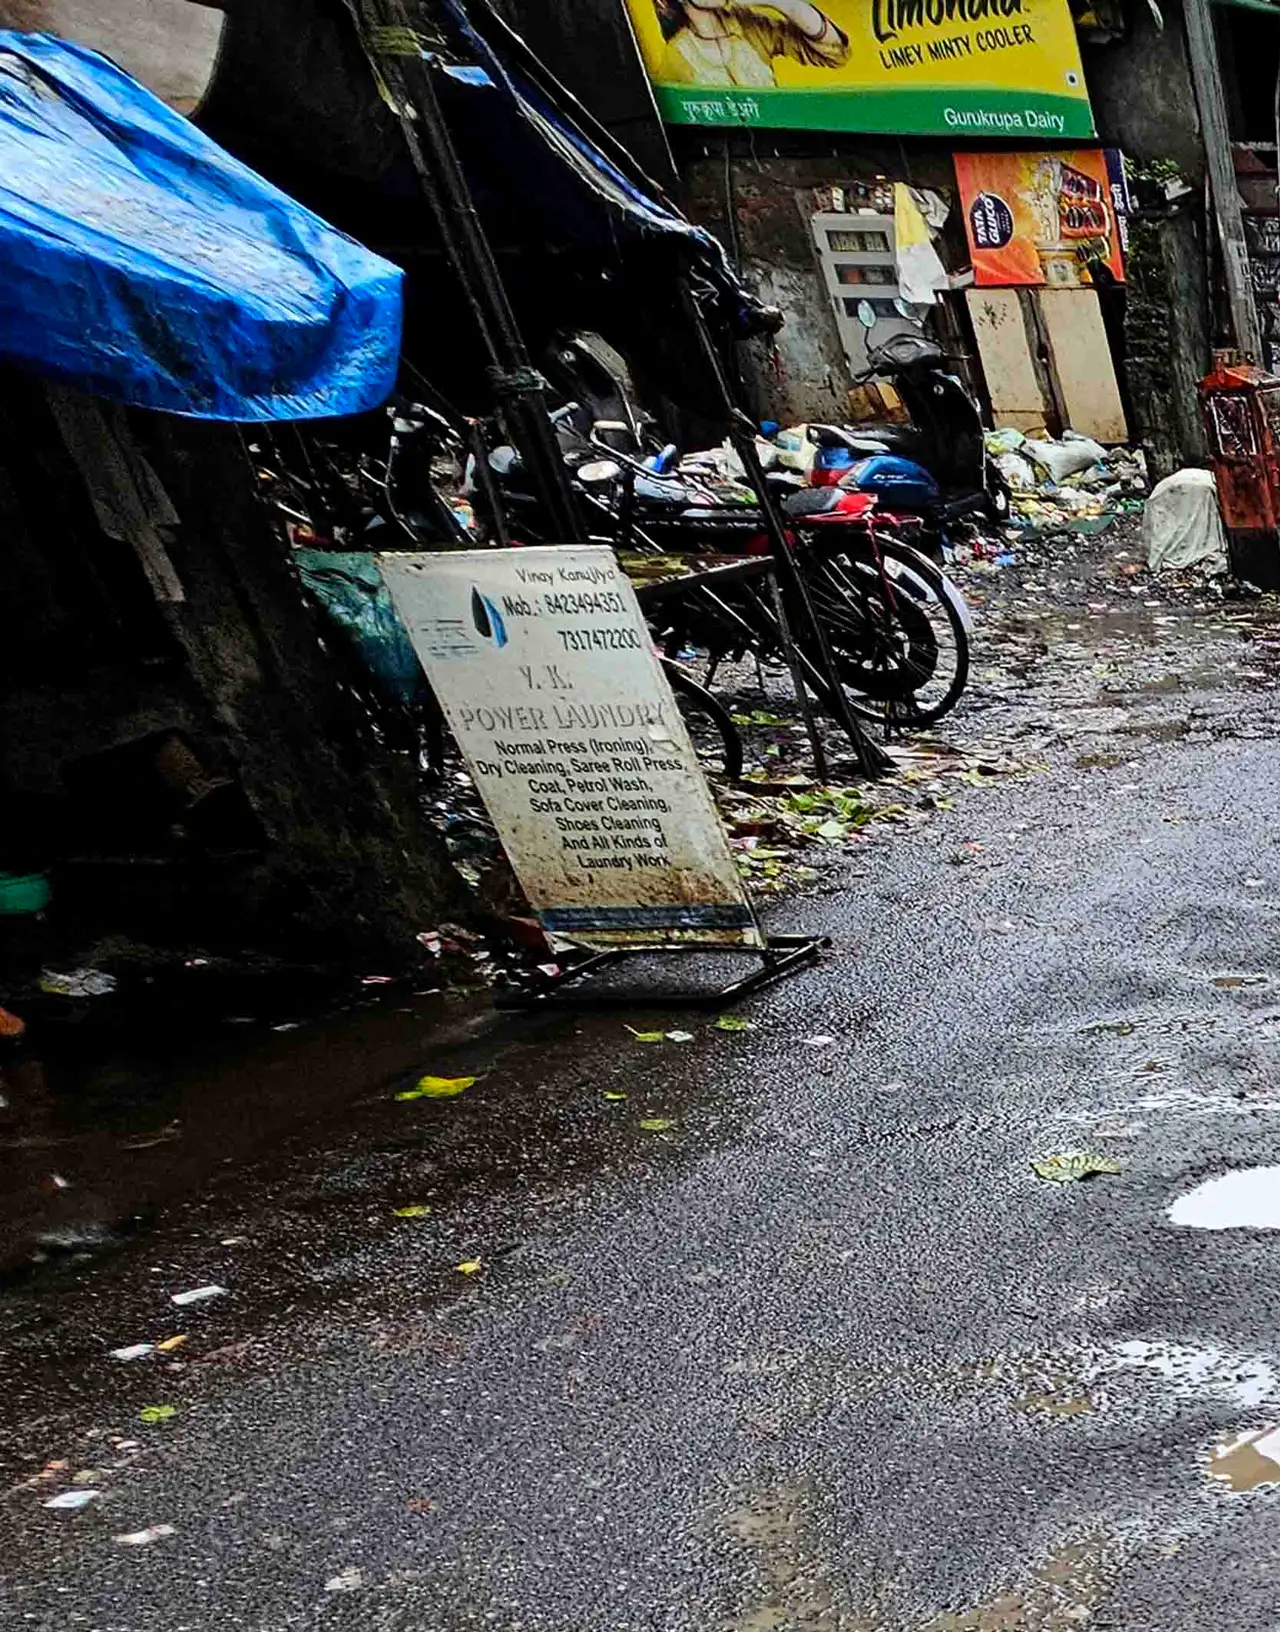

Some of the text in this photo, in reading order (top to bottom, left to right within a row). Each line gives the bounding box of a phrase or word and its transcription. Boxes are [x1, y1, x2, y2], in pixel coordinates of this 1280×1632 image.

[879, 23, 1035, 69] LIMEY MINTY COOLER
[944, 107, 1065, 132] Gurukrupa Dairy
[974, 210, 988, 244] TATA
[516, 569, 553, 586] Vinay
[544, 592, 627, 614] 8423494351
[557, 628, 642, 651] 7317472200
[459, 702, 666, 731] POWER LAUNDRY
[494, 738, 544, 756] Normal
[549, 739, 586, 755] Press
[475, 760, 502, 778] Dry
[505, 758, 570, 777] Cleaning,
[569, 758, 609, 774] Saree
[615, 756, 640, 772] Roll
[528, 777, 653, 795] Coat, Petrol Wash,
[529, 796, 671, 813] Sofa Cover Cleaning,
[555, 816, 662, 833] Shoes Cleaning
[562, 833, 668, 850] And All Kinds of
[577, 854, 671, 871] Laundry Work
